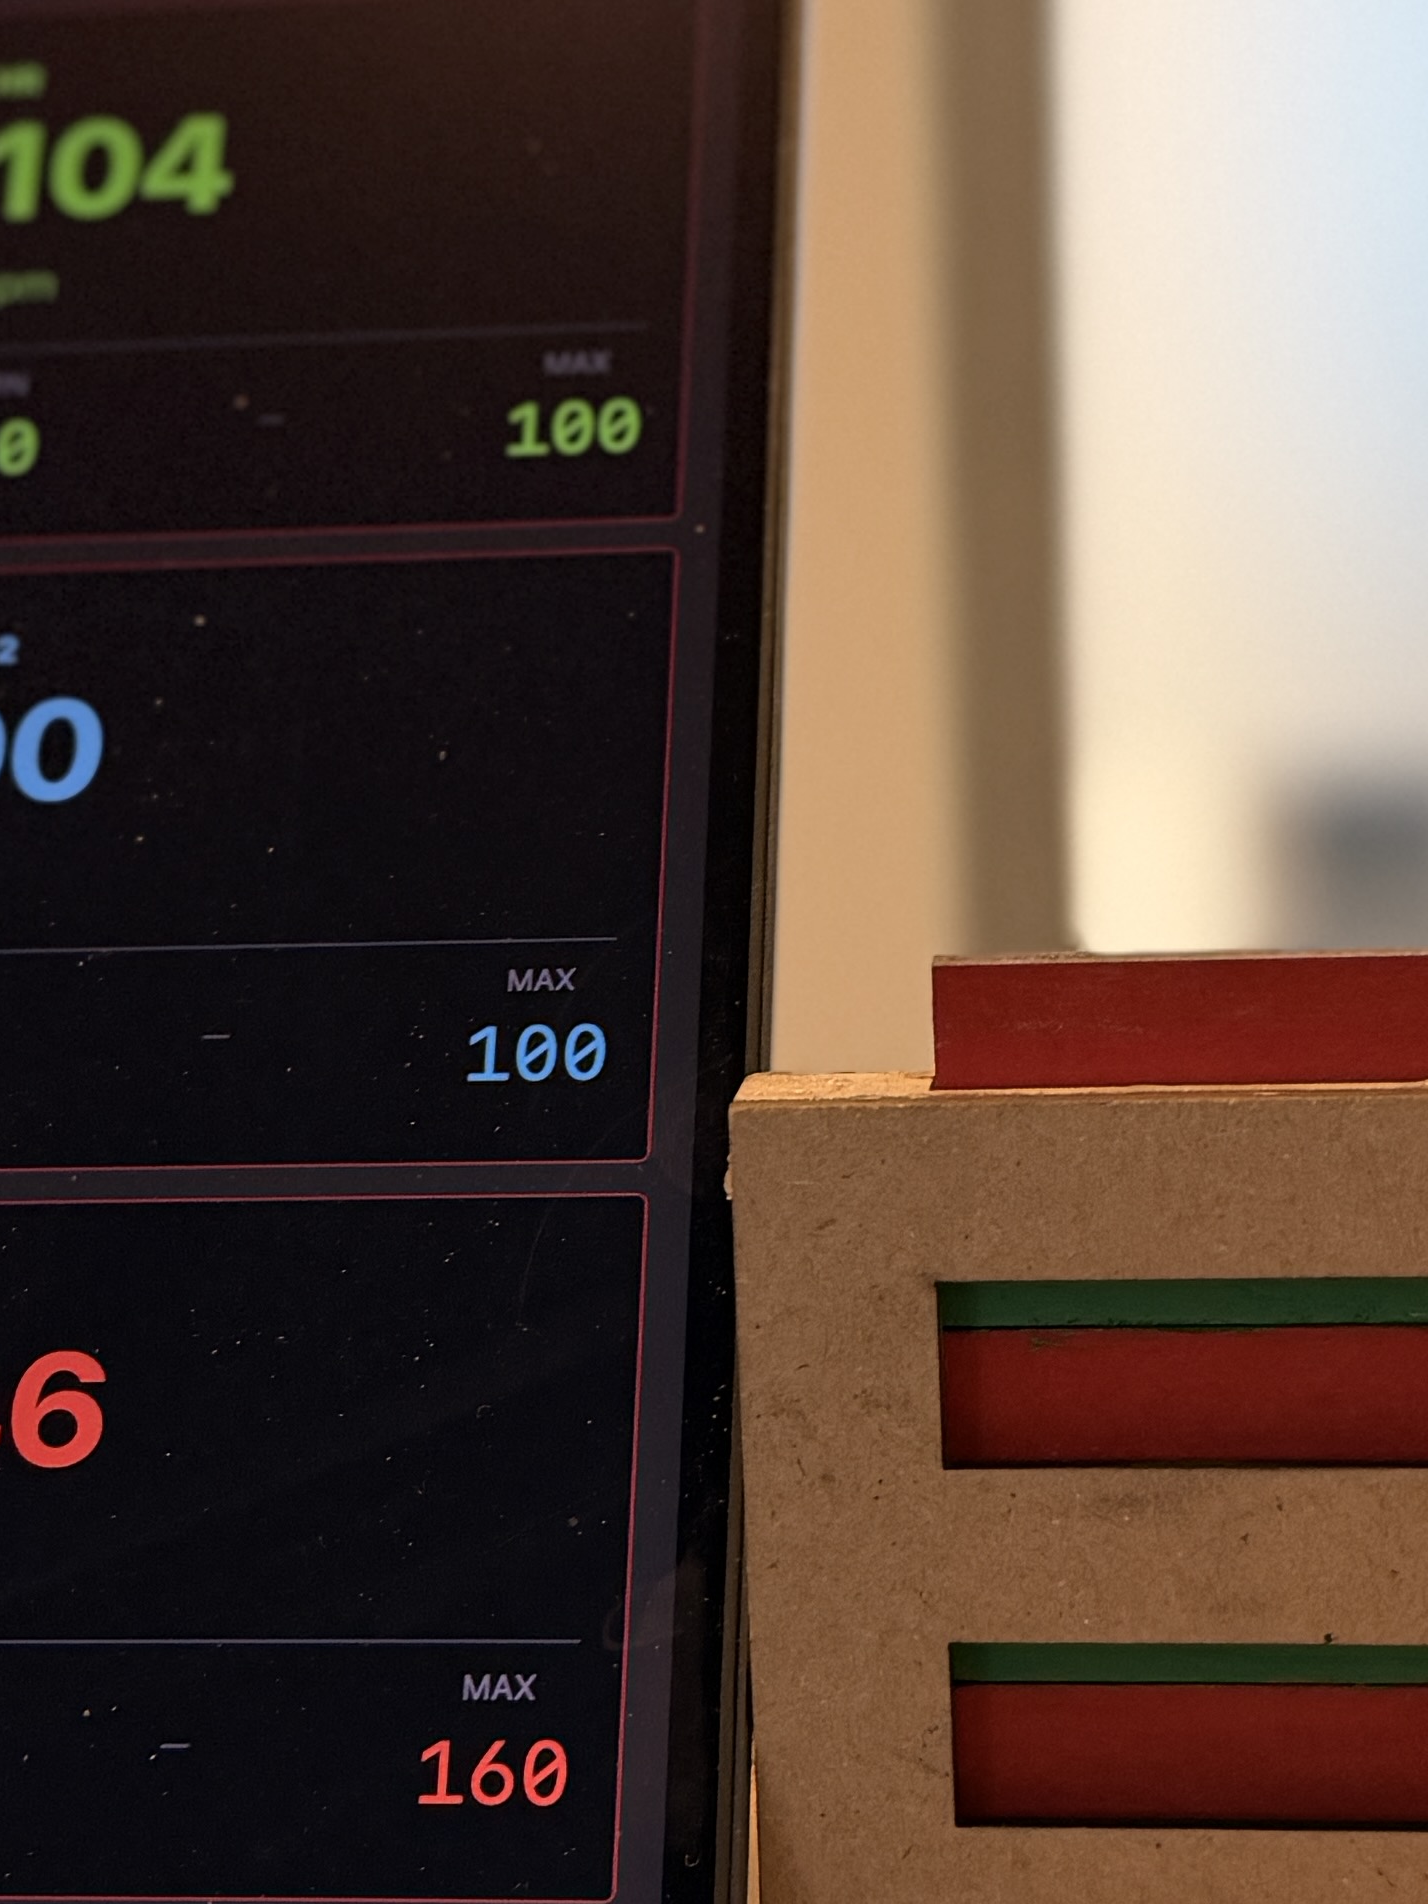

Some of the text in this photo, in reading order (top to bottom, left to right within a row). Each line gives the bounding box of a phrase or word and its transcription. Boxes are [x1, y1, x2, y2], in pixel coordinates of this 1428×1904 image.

[543, 349, 613, 375] MAX
[506, 397, 641, 458] 100
[507, 967, 577, 992] MAX
[466, 1022, 607, 1082] 100
[462, 1673, 537, 1701] MAX
[418, 1739, 568, 1807] 160
